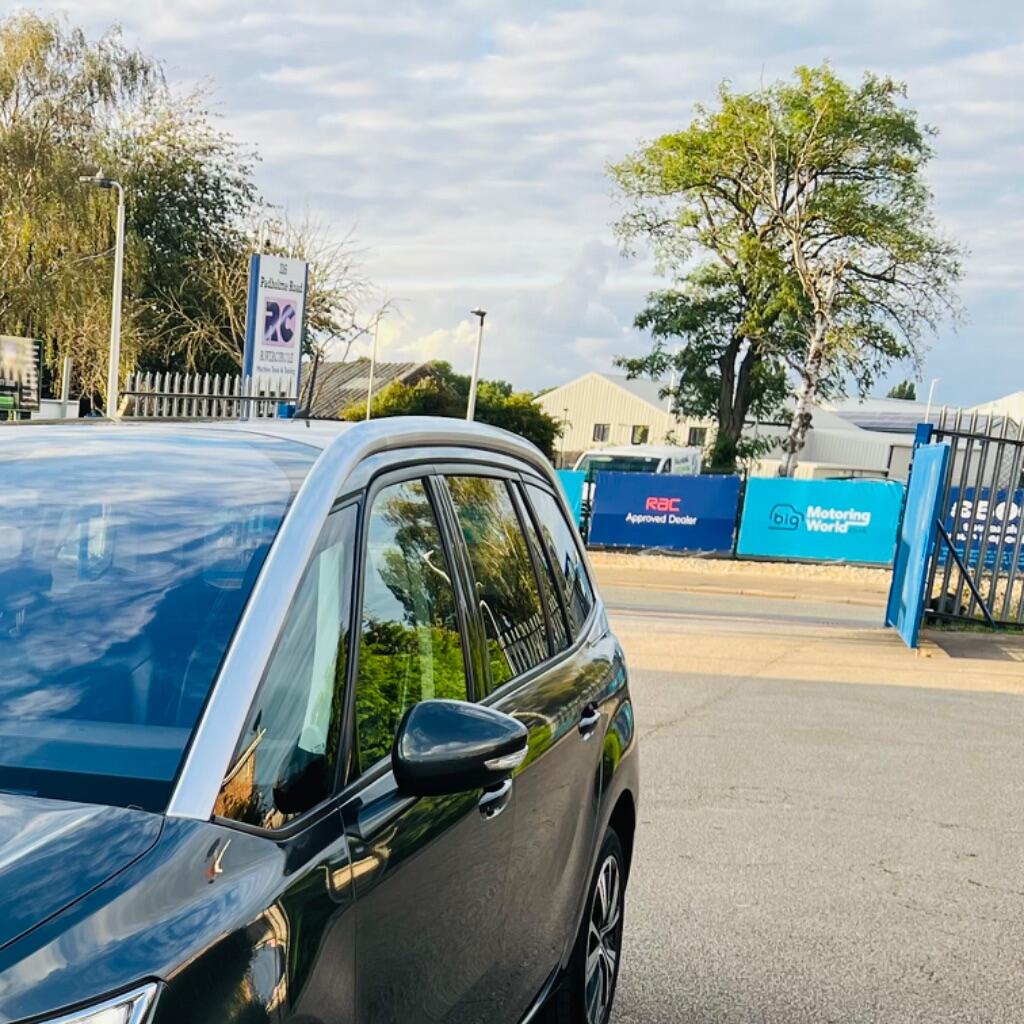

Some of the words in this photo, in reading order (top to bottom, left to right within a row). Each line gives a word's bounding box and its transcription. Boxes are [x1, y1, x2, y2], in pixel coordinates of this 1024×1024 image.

[625, 512, 666, 525] Approved
[668, 514, 697, 525] Dealer
[775, 512, 799, 529] big
[806, 505, 871, 526] Motoring
[806, 520, 849, 534] World
